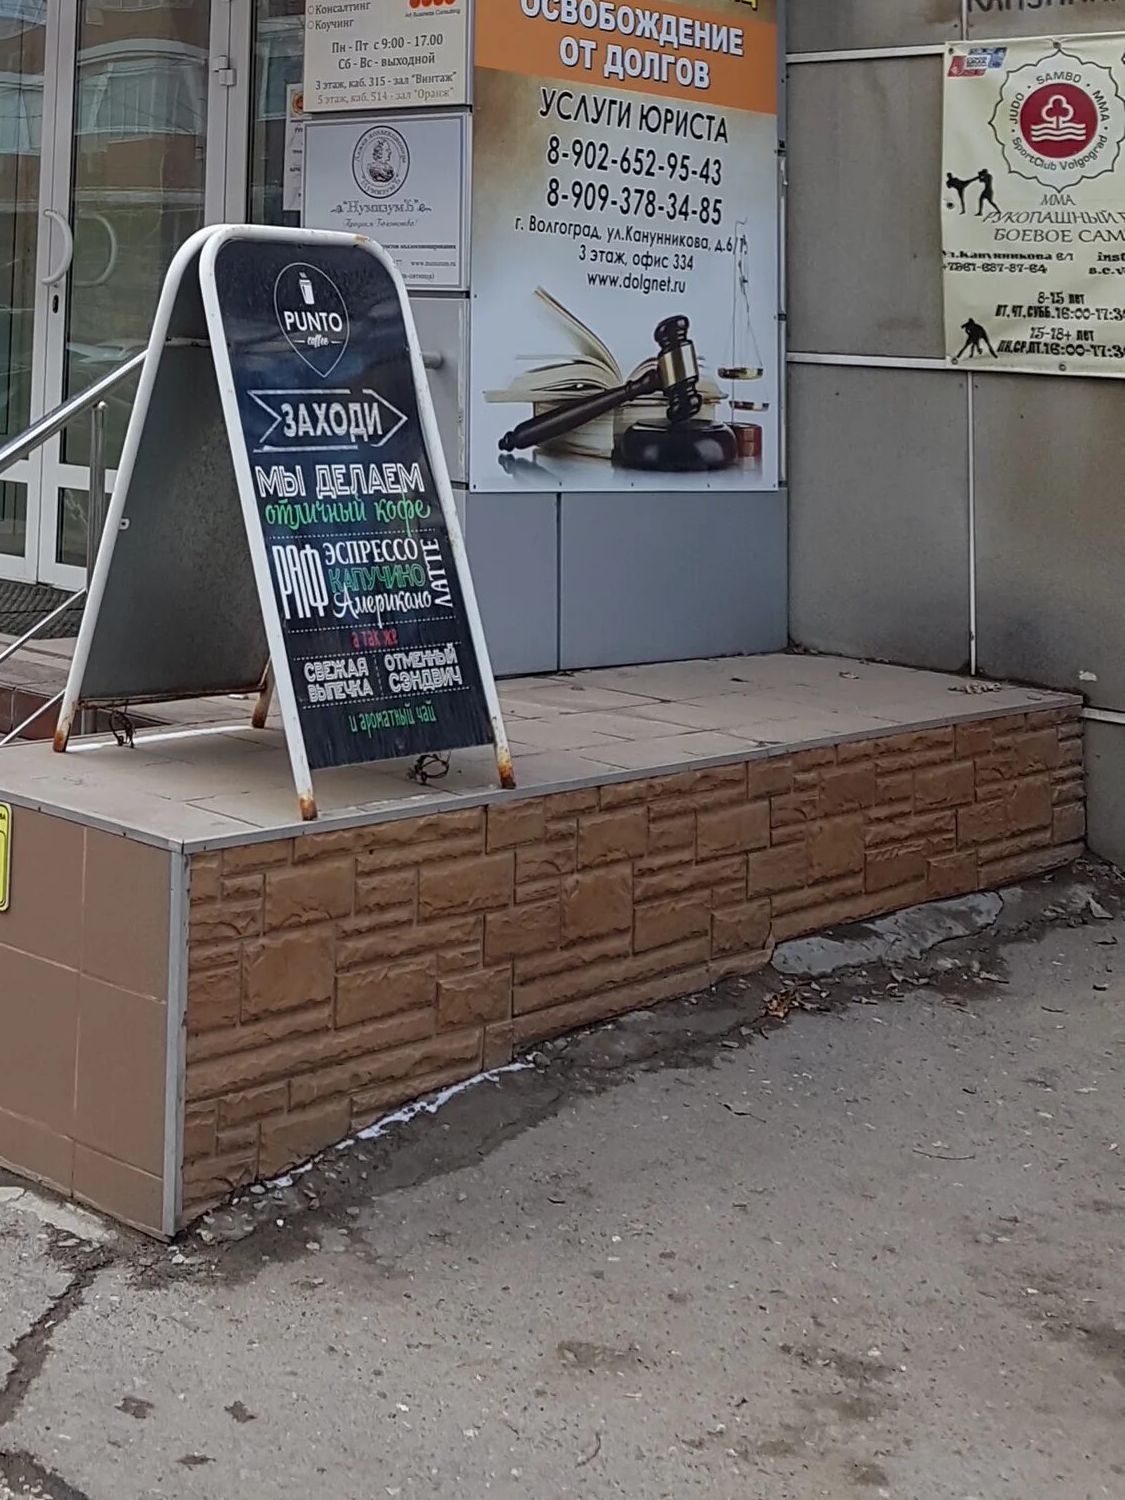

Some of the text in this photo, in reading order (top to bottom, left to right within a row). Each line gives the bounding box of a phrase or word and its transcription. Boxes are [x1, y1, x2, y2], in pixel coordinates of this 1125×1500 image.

[315, 2, 371, 15] Консалтинг
[315, 19, 355, 32] Коучинг
[332, 41, 346, 53] Пн
[355, 40, 369, 52] Пт
[381, 36, 405, 50] 9:00
[415, 33, 443, 47] 17.00
[338, 58, 351, 70] Сб
[360, 57, 373, 68] Вс
[381, 52, 435, 67] выходной
[559, 36, 711, 89] ОТ ДОЛГОВ
[315, 80, 321, 91] 3
[368, 76, 386, 87] 315
[1009, 71, 1111, 125] JUDO SAMBO MMA
[539, 88, 729, 144] УСЛУГИ ЮРИСТА
[547, 136, 722, 186] 8-902-652-95-43
[546, 178, 723, 225] 8-909-378-34-85
[982, 209, 1119, 225] РУКОПАШНЫЙ
[994, 228, 1073, 243] БОЕВОЕ
[579, 244, 694, 271] 3 этаж, офис 334
[587, 272, 686, 294] www.dolgnet.ru
[284, 310, 343, 332] PUNTO
[307, 334, 329, 348] coffee
[282, 402, 383, 442] ЗАХОДИ
[254, 462, 425, 499] МЫ ДЕЛАЕМ
[265, 492, 431, 538] отличный кофе
[322, 537, 418, 565] ЭСПРЕССО
[272, 543, 329, 620] РАФ
[328, 563, 426, 593] КАПУЧИНО
[423, 537, 453, 608] ЛАТТЕ
[332, 582, 432, 629] Американо
[352, 628, 400, 648] а так же
[304, 642, 458, 683] СВЕЖАЯ ОТМЕННЫЙ
[307, 665, 463, 703] ВЫПЕЧКА СЭНДВИЧ
[349, 700, 437, 738] и ароматный чай
